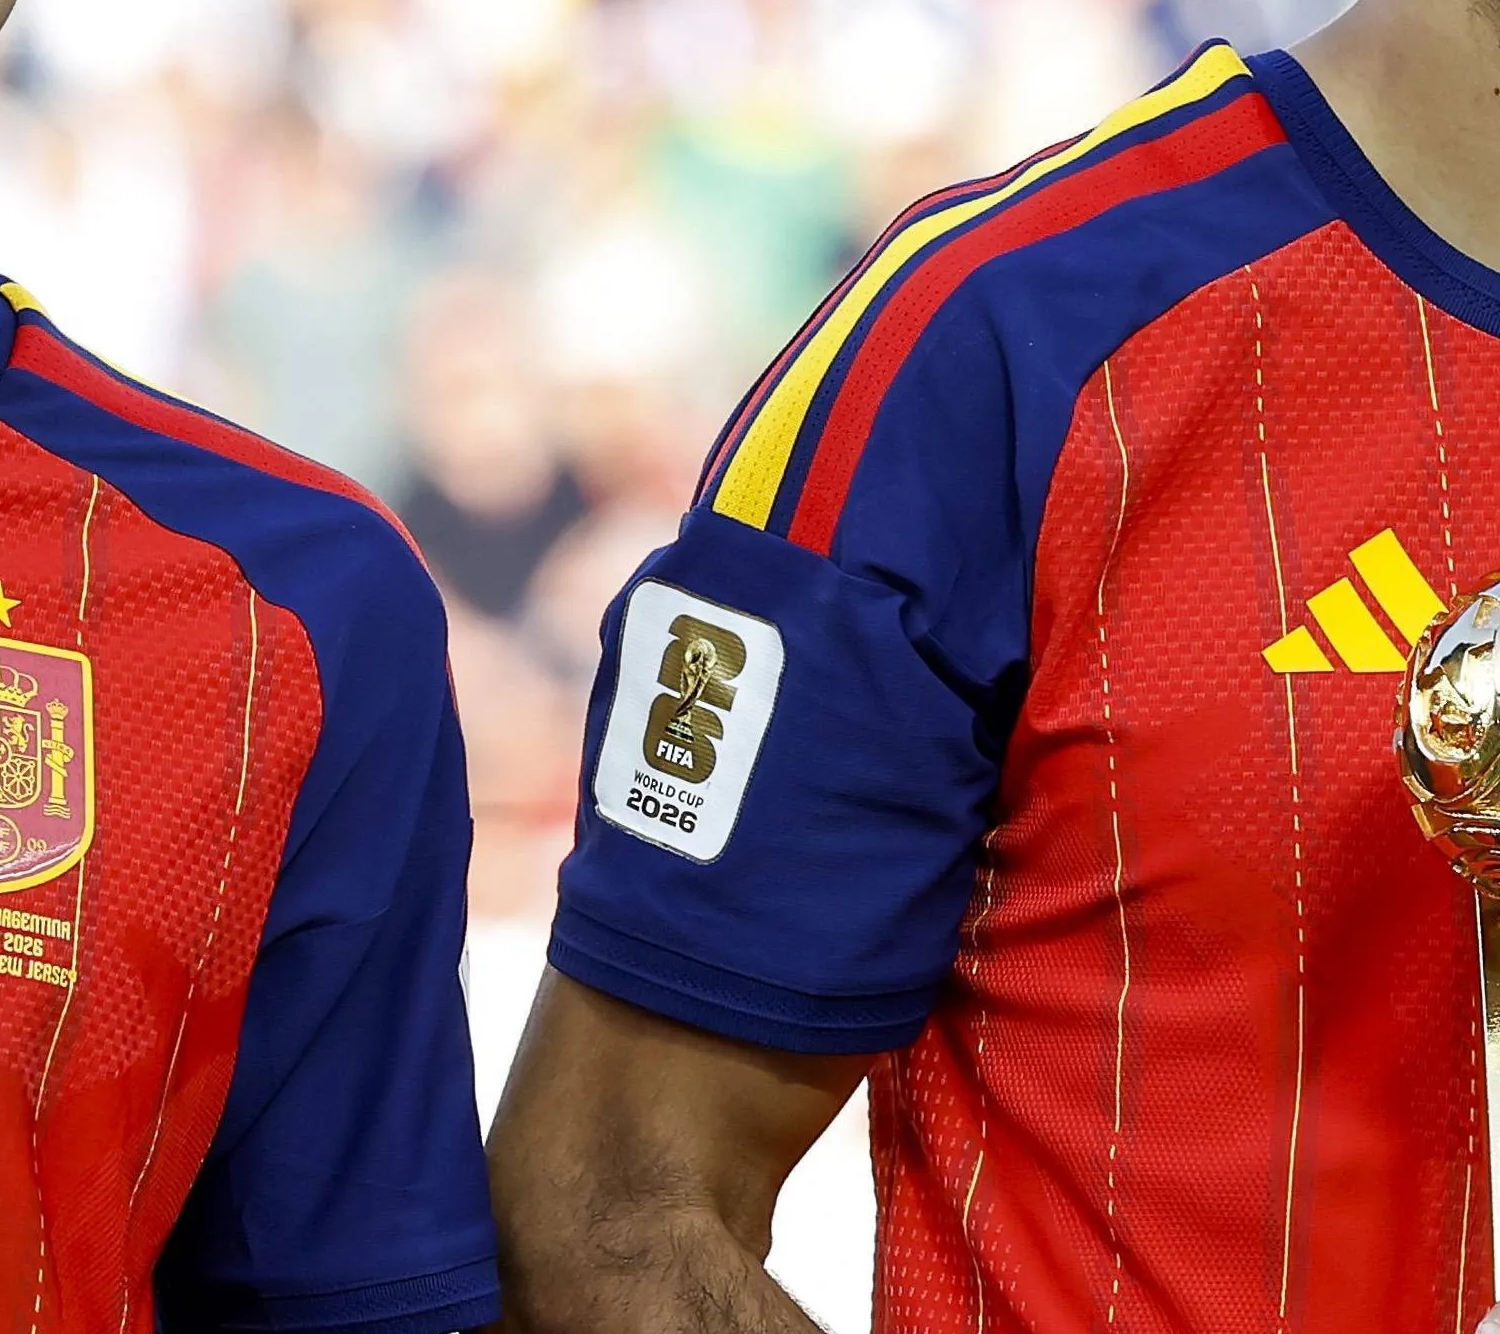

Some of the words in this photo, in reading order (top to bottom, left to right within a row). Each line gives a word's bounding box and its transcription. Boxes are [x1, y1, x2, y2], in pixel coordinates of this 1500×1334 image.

[656, 739, 694, 769] FIFA
[634, 769, 676, 798] WORLD
[678, 790, 704, 808] CUP
[626, 787, 698, 834] 2026
[3, 932, 44, 957] 2026
